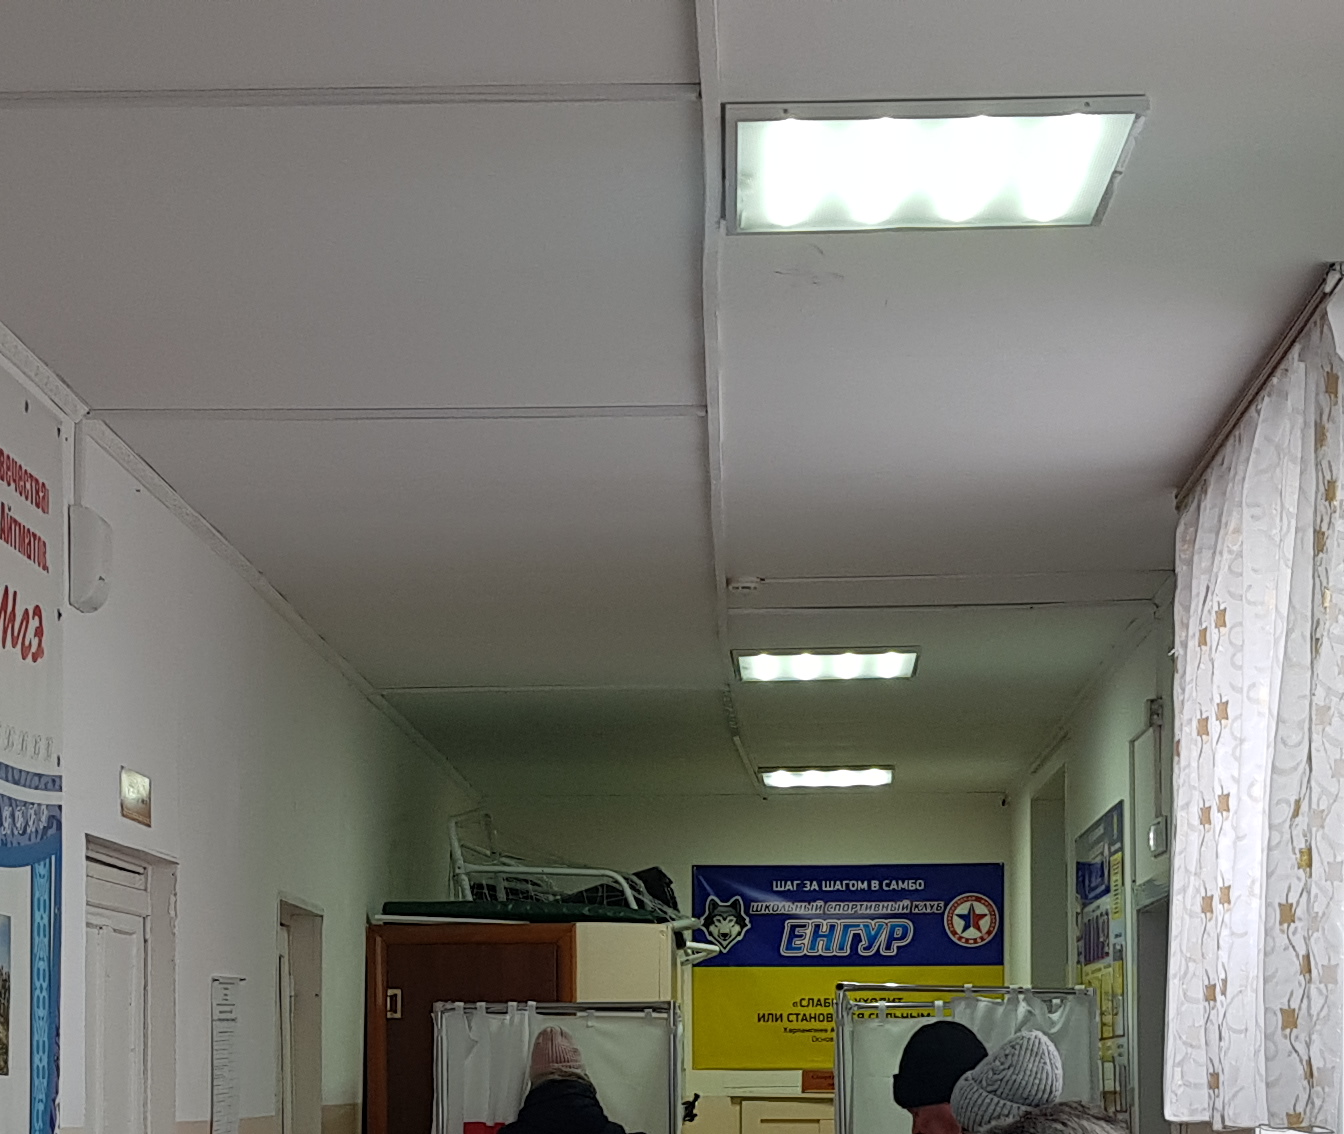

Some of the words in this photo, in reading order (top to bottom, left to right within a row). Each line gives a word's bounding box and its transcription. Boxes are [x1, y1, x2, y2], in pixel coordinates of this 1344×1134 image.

[772, 880, 801, 891] ШАГ
[803, 880, 819, 891] ЗА
[822, 880, 868, 891] ШАГОМ
[871, 880, 880, 890] В
[882, 879, 925, 890] САМБО
[750, 901, 823, 914] ШКОЛЬНЫЙ
[825, 900, 910, 913] СПОРТИВНЫЙ
[912, 901, 945, 913] КЛУБ
[780, 919, 914, 956] ЕНГУР
[757, 1013, 783, 1023] ИЛИ
